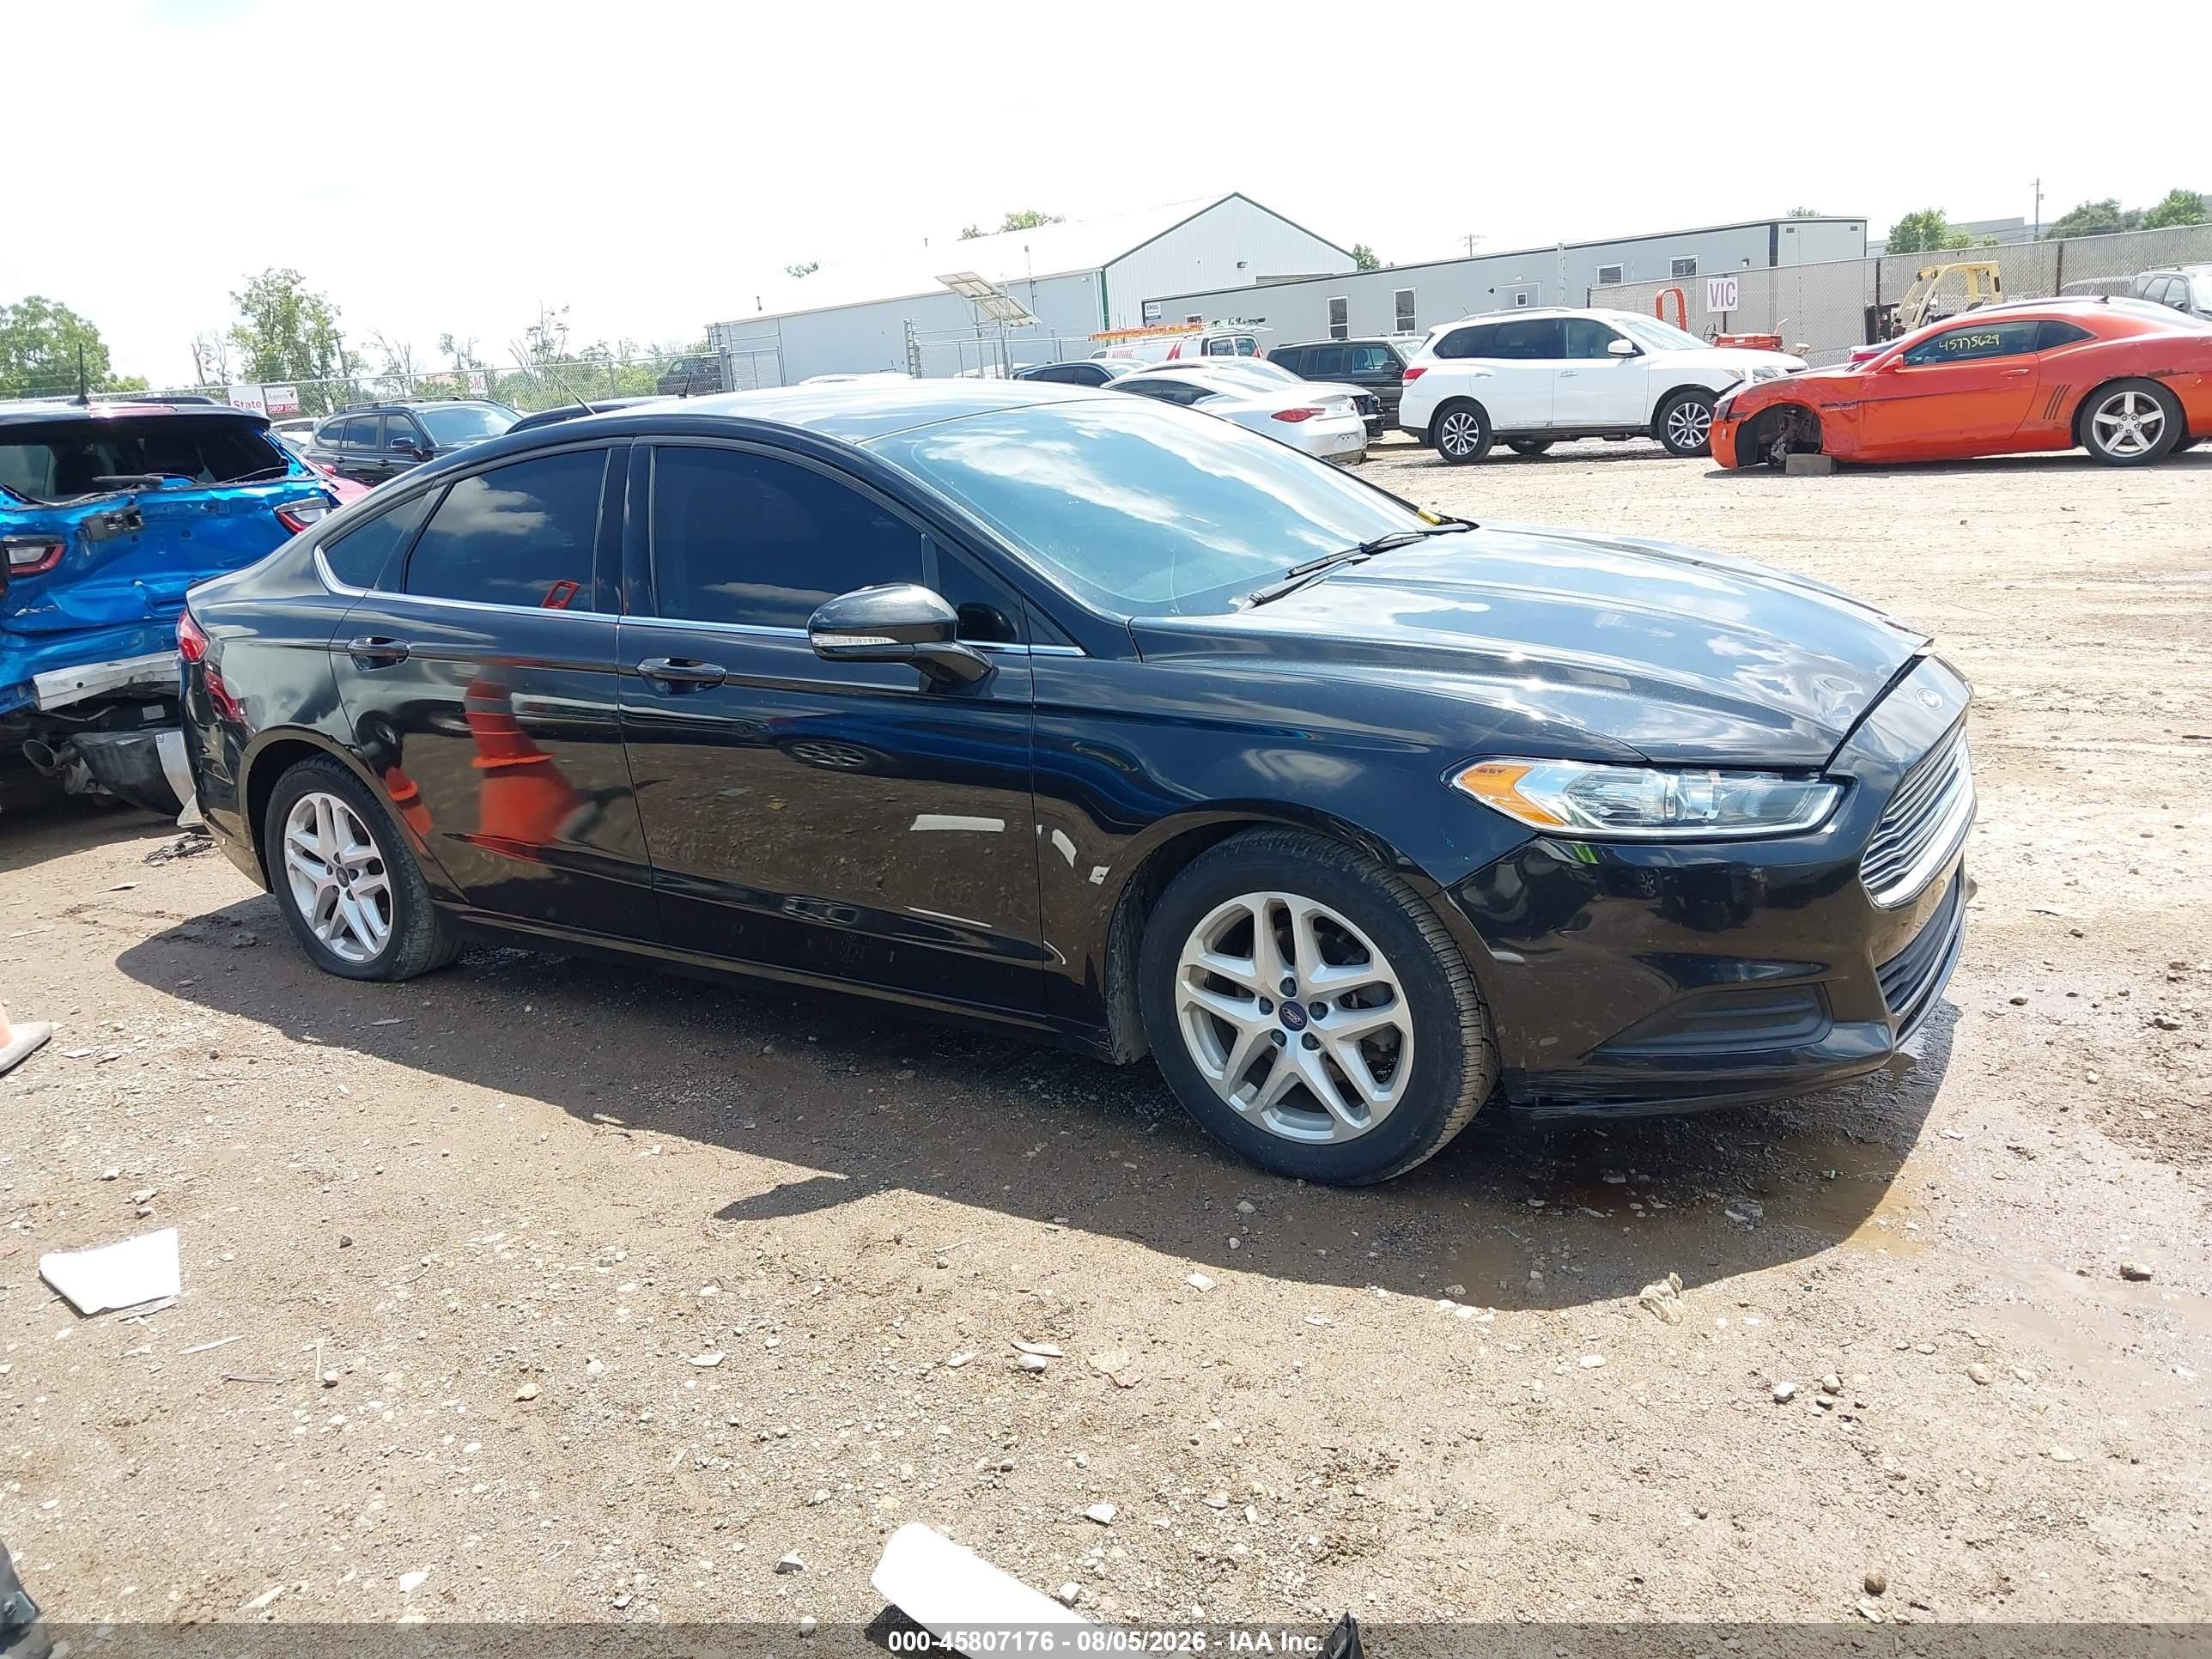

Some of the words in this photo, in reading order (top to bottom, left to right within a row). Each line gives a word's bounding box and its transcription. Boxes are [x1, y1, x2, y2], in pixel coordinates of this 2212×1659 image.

[1710, 281, 1736, 307] VIC
[1938, 334, 2000, 351] 45775629
[233, 399, 262, 410] State
[268, 404, 284, 413] DROP
